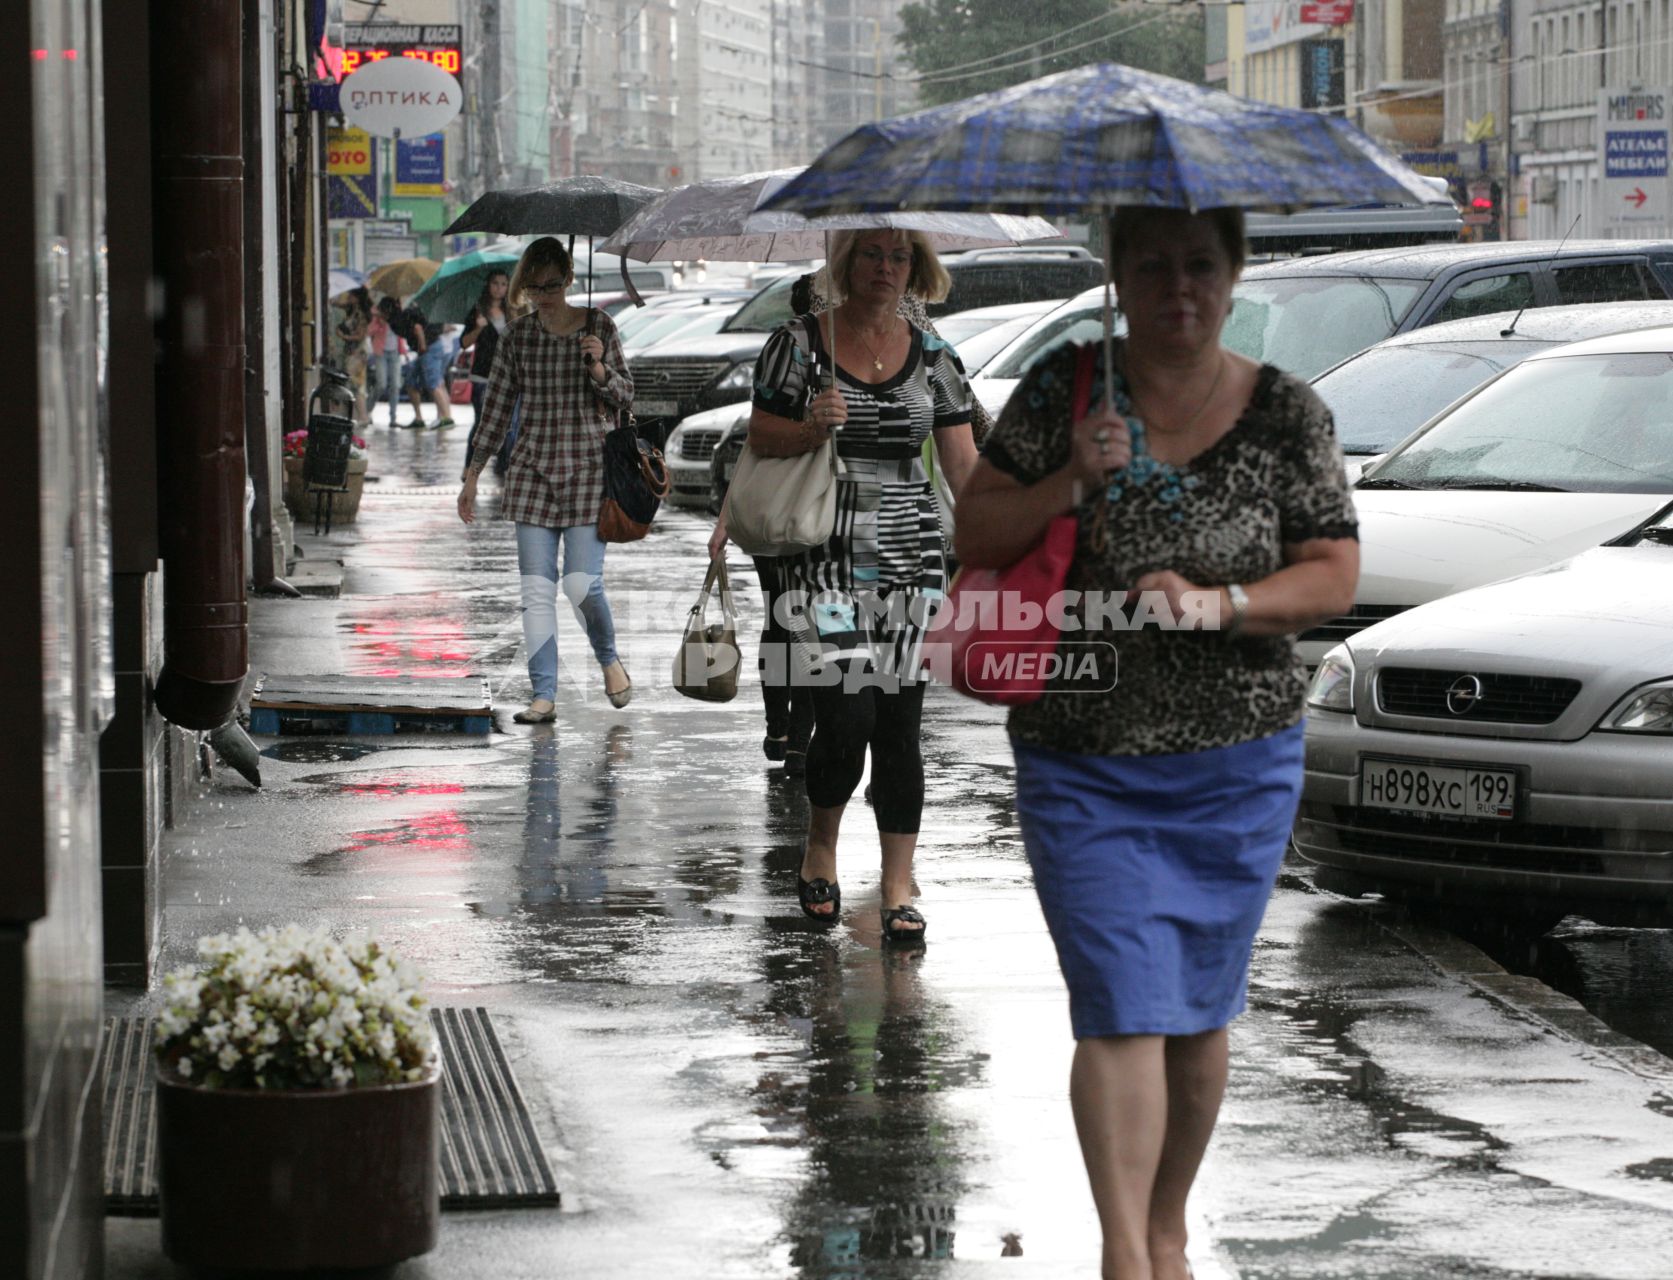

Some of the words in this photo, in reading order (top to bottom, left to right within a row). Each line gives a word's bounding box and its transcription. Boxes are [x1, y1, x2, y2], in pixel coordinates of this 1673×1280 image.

[423, 27, 460, 43] КАССА
[1607, 138, 1666, 152] АТЕЛЬЕ
[328, 151, 367, 165] ОТО
[1607, 156, 1667, 170] МЕБЕЛИ
[1370, 768, 1463, 809] Н898ХС
[1469, 773, 1509, 803] 199
[1477, 803, 1497, 814] RUS
